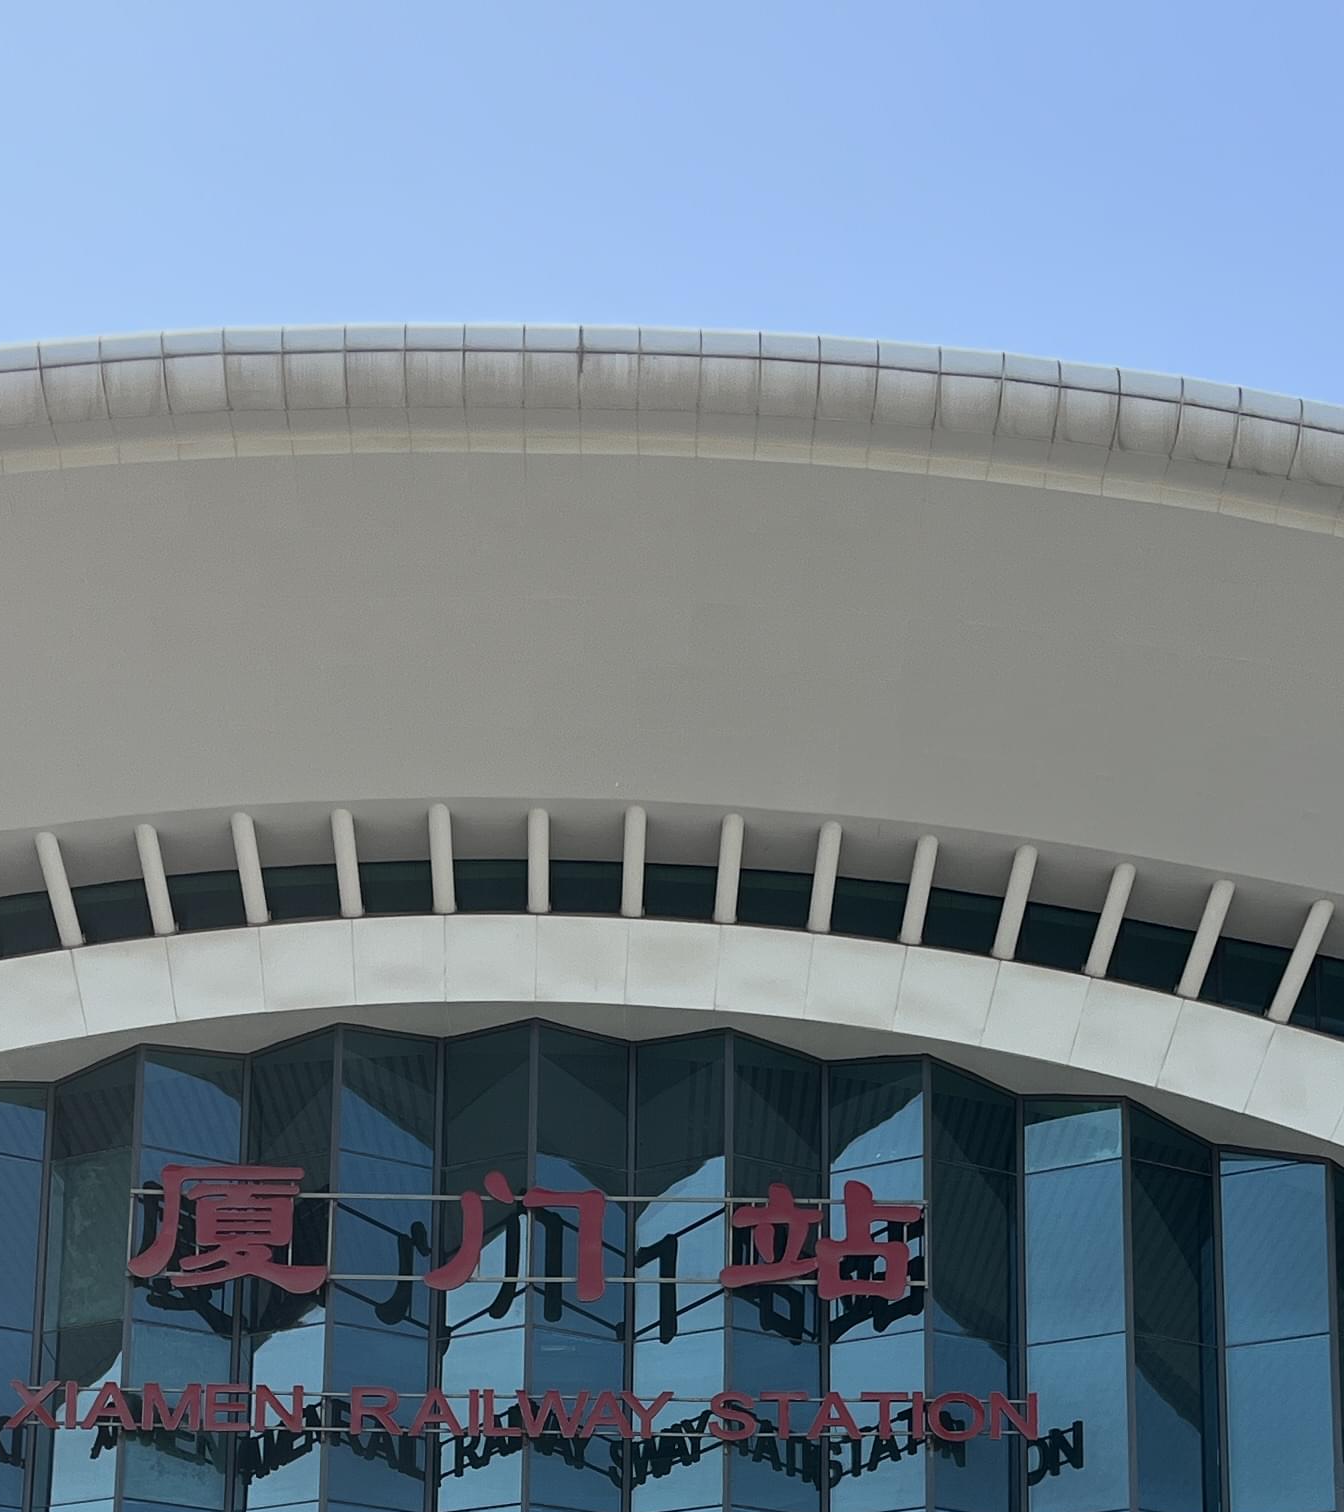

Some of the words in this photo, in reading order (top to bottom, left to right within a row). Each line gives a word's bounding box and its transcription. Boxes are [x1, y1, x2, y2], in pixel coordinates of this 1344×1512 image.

[127, 1163, 923, 1302] 厦门站
[2, 1378, 304, 1432] XIAMEN
[349, 1385, 674, 1440] RAILWAY
[707, 1391, 1039, 1442] STATION
